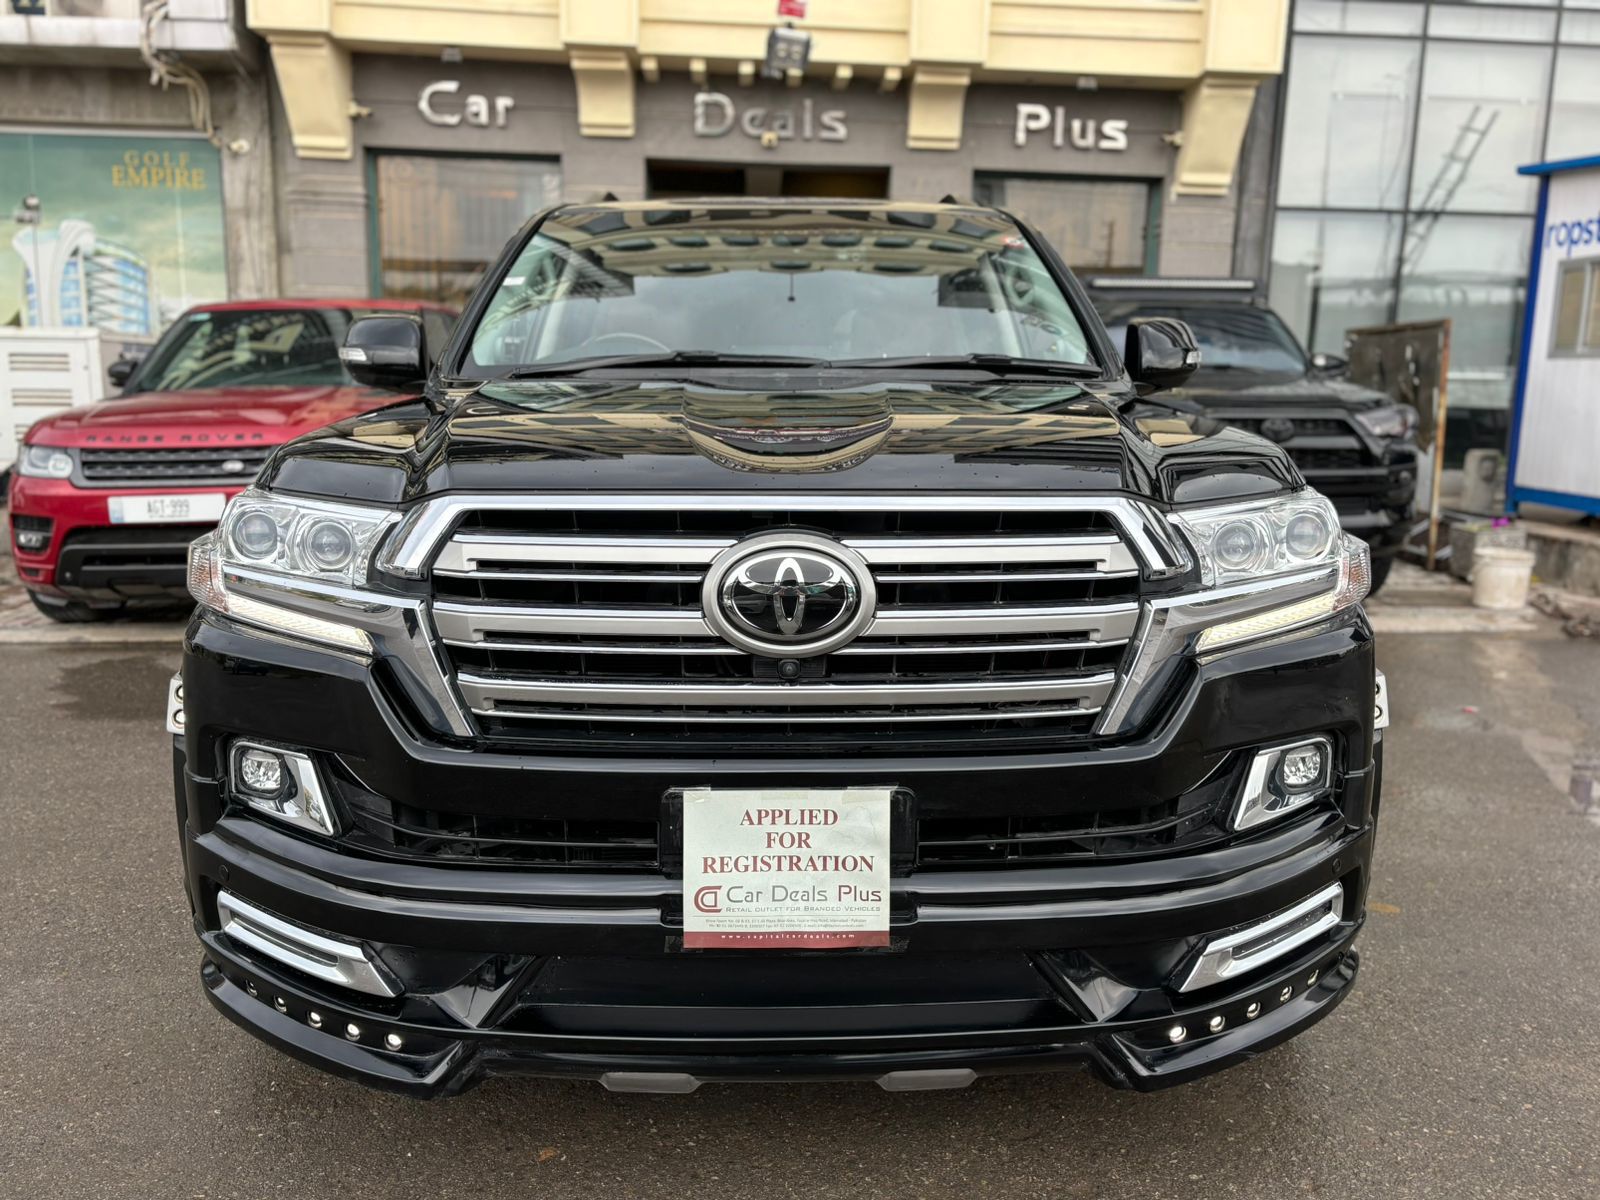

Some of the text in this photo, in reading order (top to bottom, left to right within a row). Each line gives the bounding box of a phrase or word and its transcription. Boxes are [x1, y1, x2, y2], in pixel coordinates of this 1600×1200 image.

[418, 80, 1128, 150] Car Deals Plus
[111, 164, 208, 190] EMPIRE
[85, 432, 264, 443] RANGE ROVER
[740, 808, 839, 826] APPLIED
[765, 831, 812, 849] FOR
[702, 855, 875, 874] REGISTRATION
[726, 884, 882, 903] Car Deals Plus
